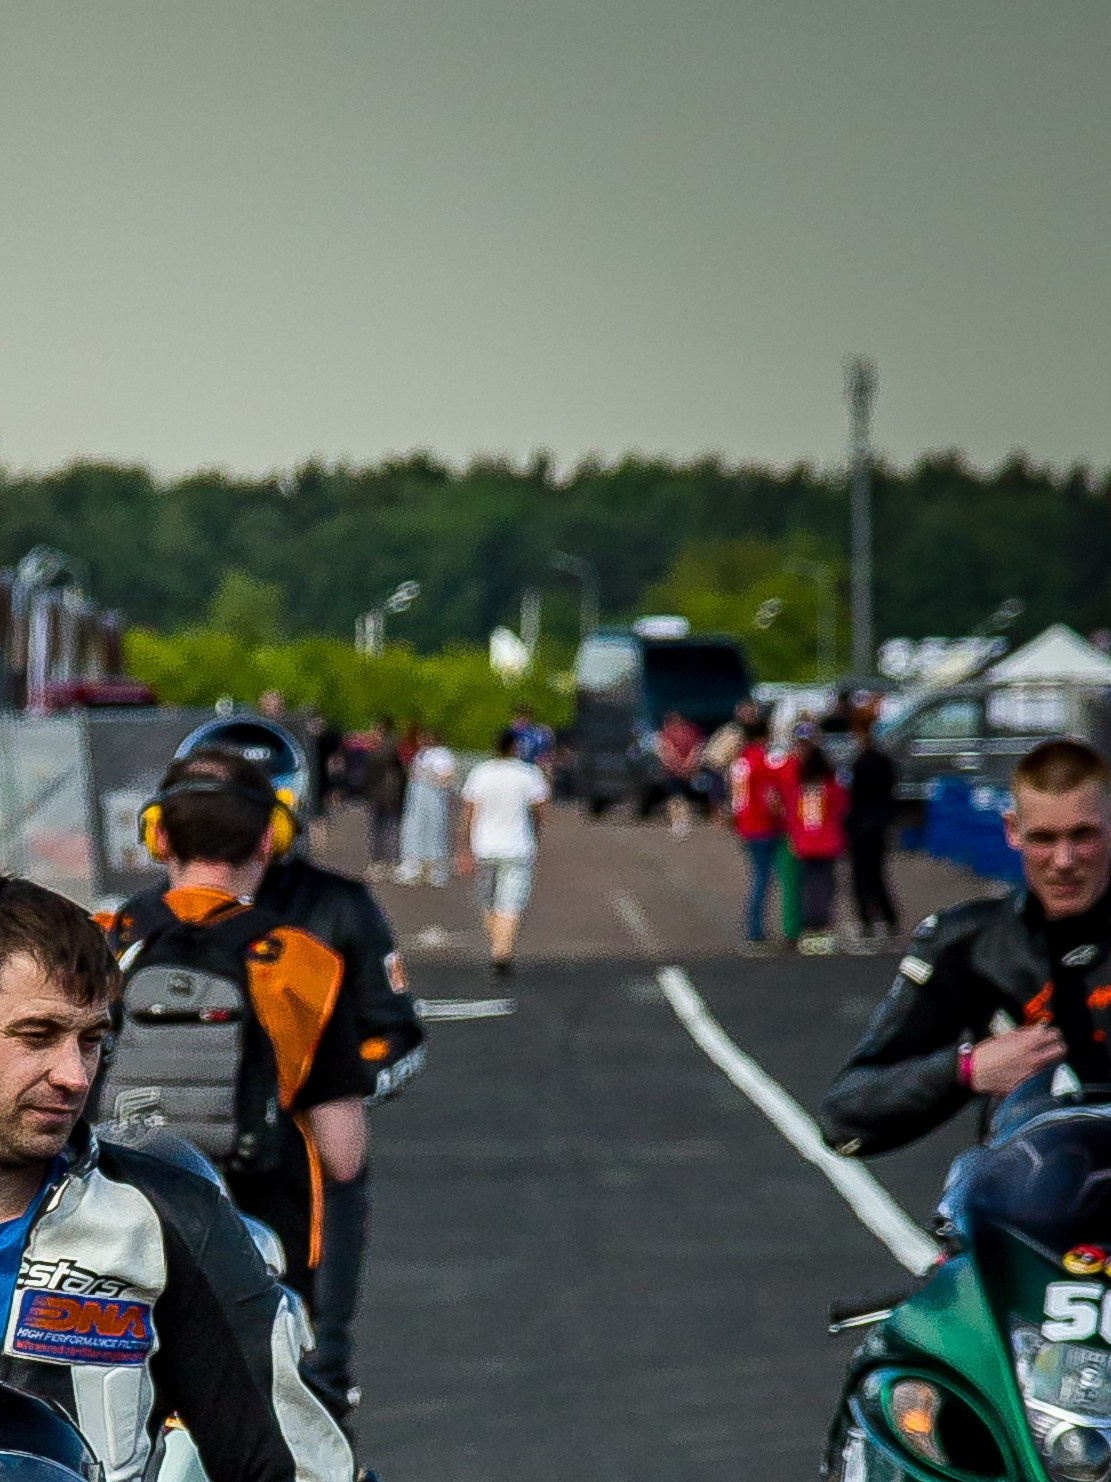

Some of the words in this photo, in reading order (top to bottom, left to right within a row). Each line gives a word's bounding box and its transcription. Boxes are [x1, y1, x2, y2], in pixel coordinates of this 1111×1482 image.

[16, 1327, 44, 1341] HIGH
[25, 1294, 147, 1339] DNA
[1041, 1281, 1111, 1345] 5
